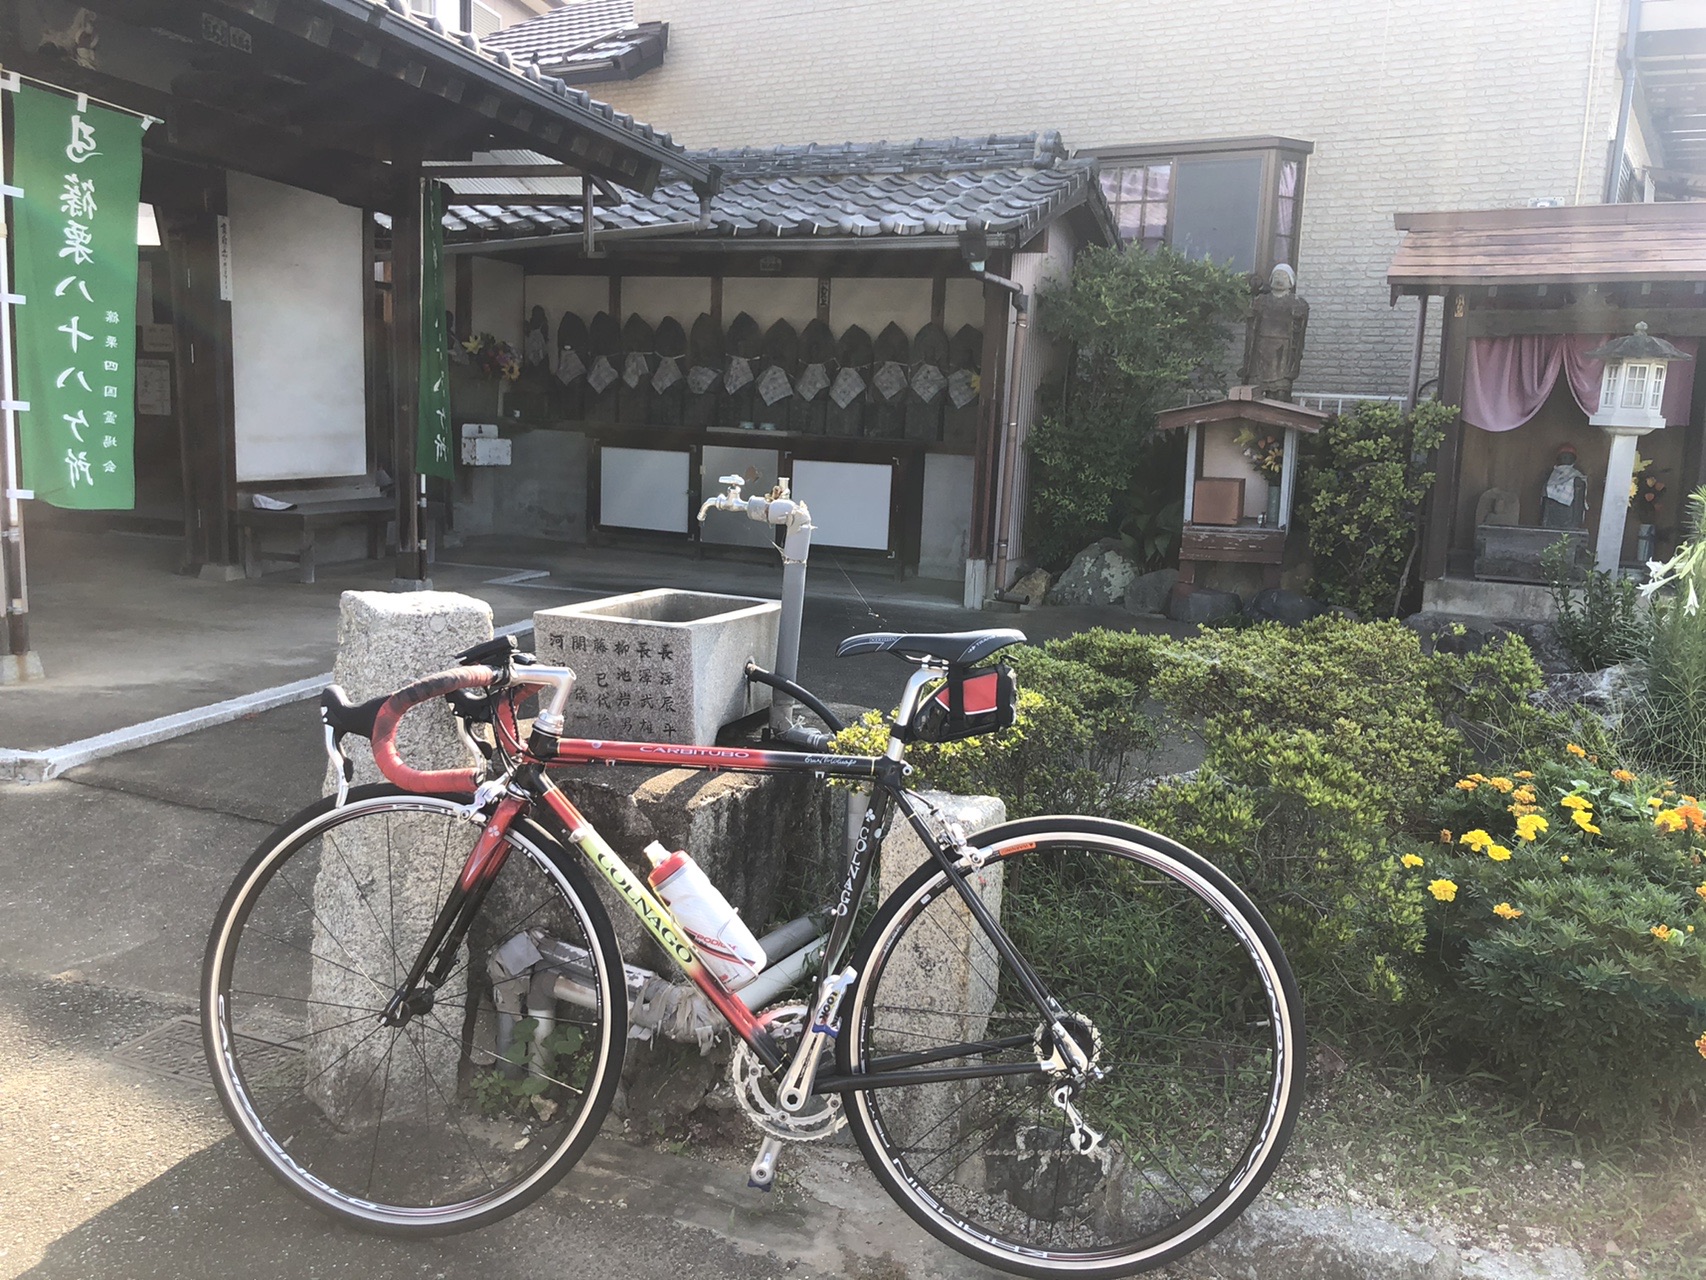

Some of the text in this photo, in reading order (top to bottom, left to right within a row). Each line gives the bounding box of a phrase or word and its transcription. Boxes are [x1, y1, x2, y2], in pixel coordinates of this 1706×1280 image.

[640, 746, 750, 758] CARBITUBO
[597, 852, 693, 963] COLNAGO
[836, 826, 870, 917] COLNAGO
[819, 991, 839, 1020] LOOK
[1223, 911, 1284, 1191] CAMPAGNOLO
[860, 1006, 890, 1148] ASYMETRIC
[893, 1157, 1048, 1259] KHAMSIN
